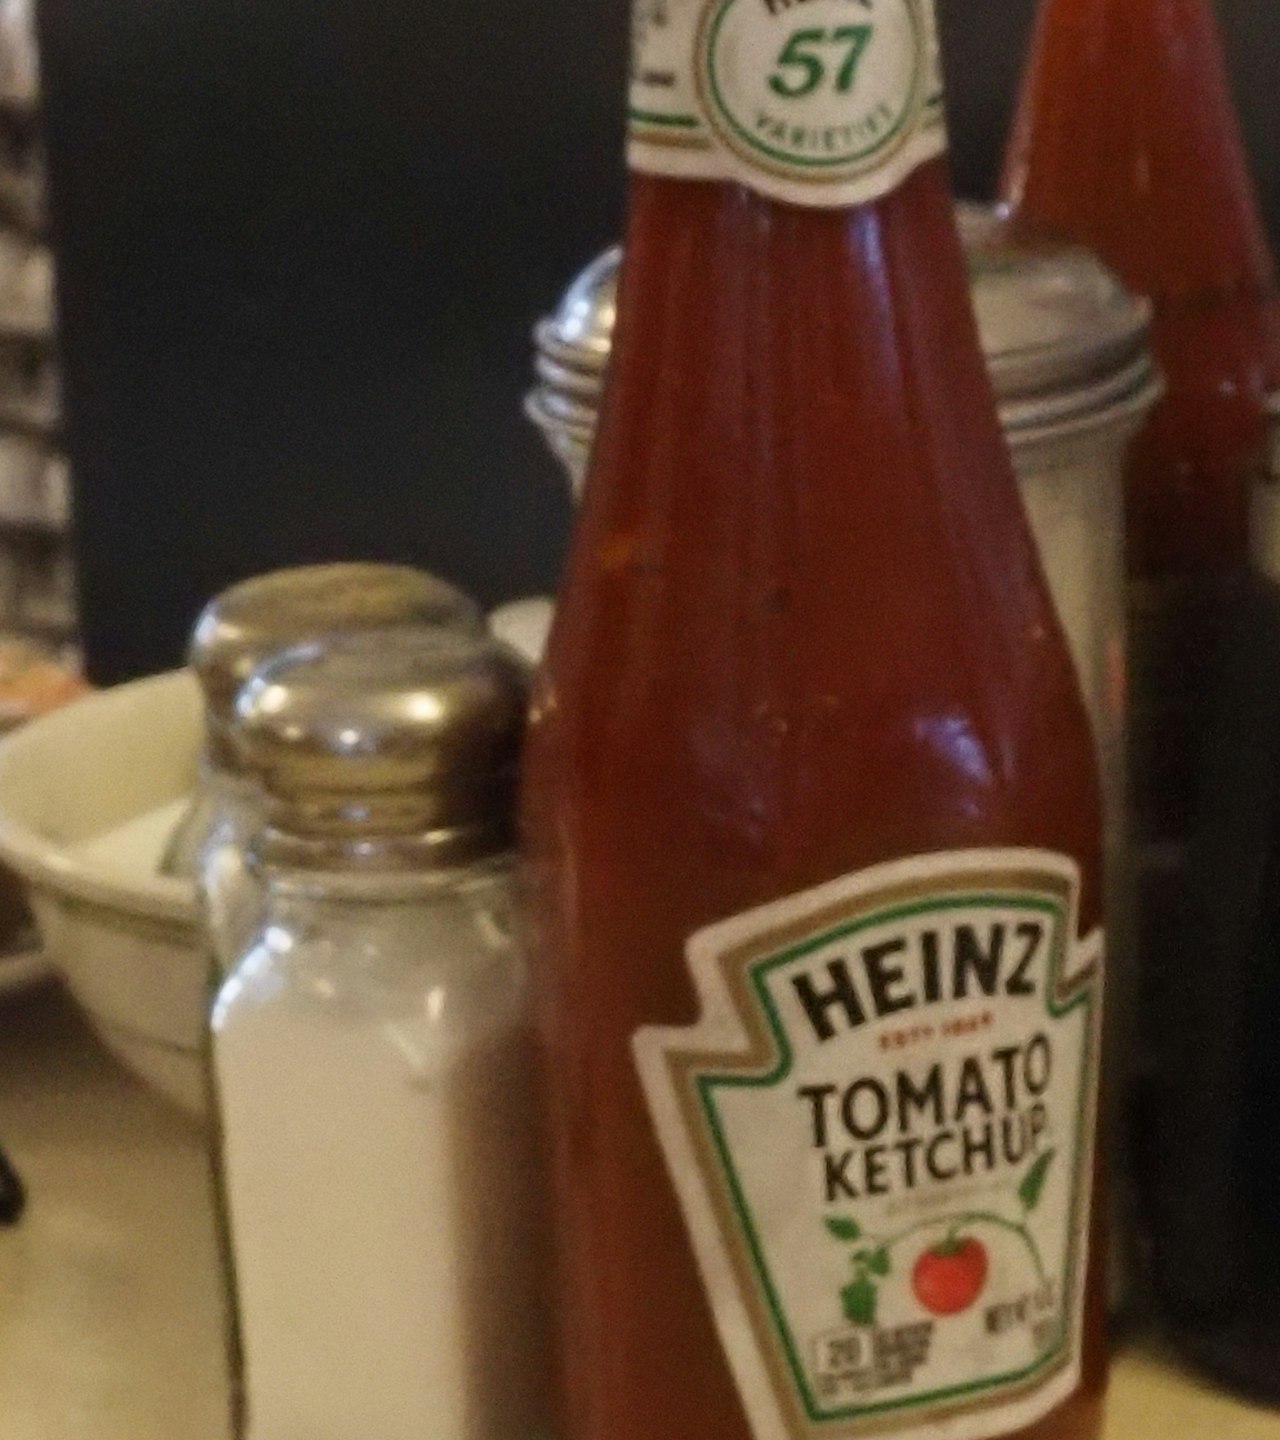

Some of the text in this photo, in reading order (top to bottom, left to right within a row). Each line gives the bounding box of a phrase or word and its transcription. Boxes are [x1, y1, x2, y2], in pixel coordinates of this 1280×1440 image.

[767, 23, 874, 99] 57
[791, 920, 1045, 1040] HEINZ
[797, 1030, 1053, 1149] TOMATO
[823, 1102, 1047, 1203] KETCHUP
